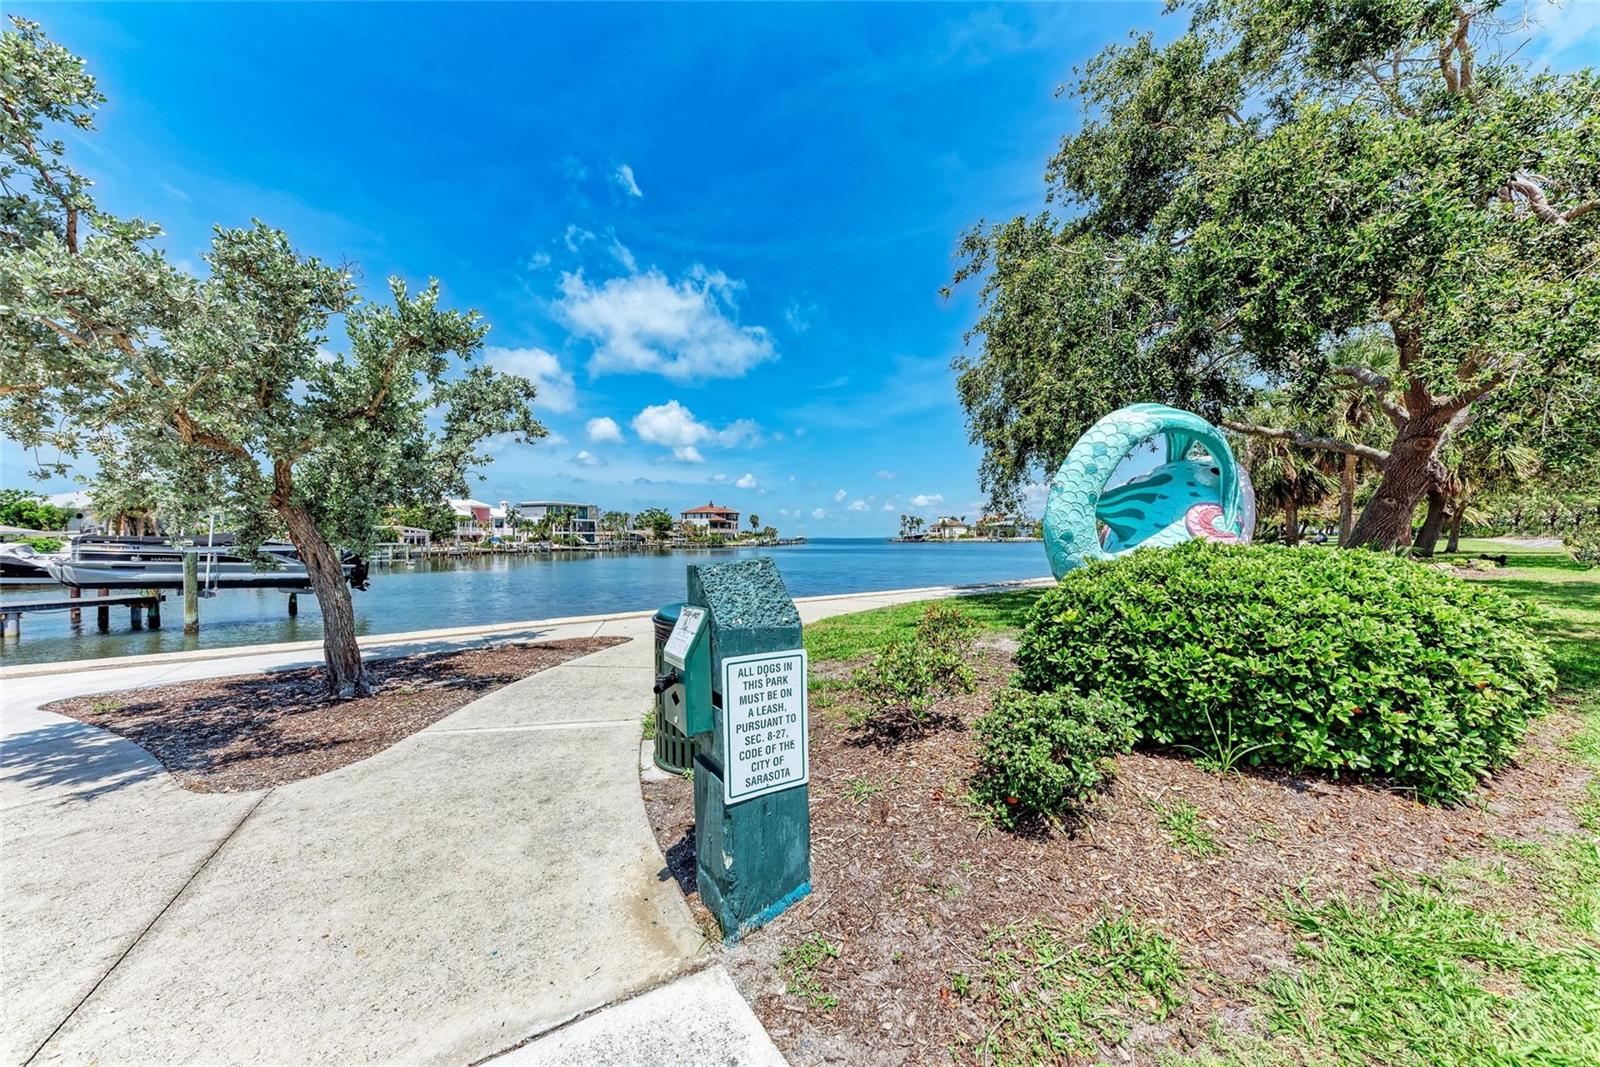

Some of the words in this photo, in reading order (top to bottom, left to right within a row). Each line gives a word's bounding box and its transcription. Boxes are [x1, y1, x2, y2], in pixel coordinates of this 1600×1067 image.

[738, 667, 754, 678] ALL
[757, 663, 781, 675] DOGS
[784, 662, 792, 671] IN
[743, 679, 763, 690] THIS
[766, 675, 788, 687] PARK
[739, 692, 765, 705] MUST
[767, 690, 777, 700] BE
[780, 688, 792, 698] ON
[748, 708, 754, 717] A
[756, 703, 787, 716] LEASH,
[736, 716, 783, 734] PURSUANT
[785, 713, 796, 723] TO
[745, 733, 764, 746] SEC.
[767, 729, 788, 741] 8-27,
[739, 747, 763, 761] CODE
[765, 744, 776, 755] OF
[779, 740, 795, 752] THE
[751, 758, 770, 772] CITY
[773, 755, 784, 767] OF
[745, 768, 790, 787] SARASOTA
